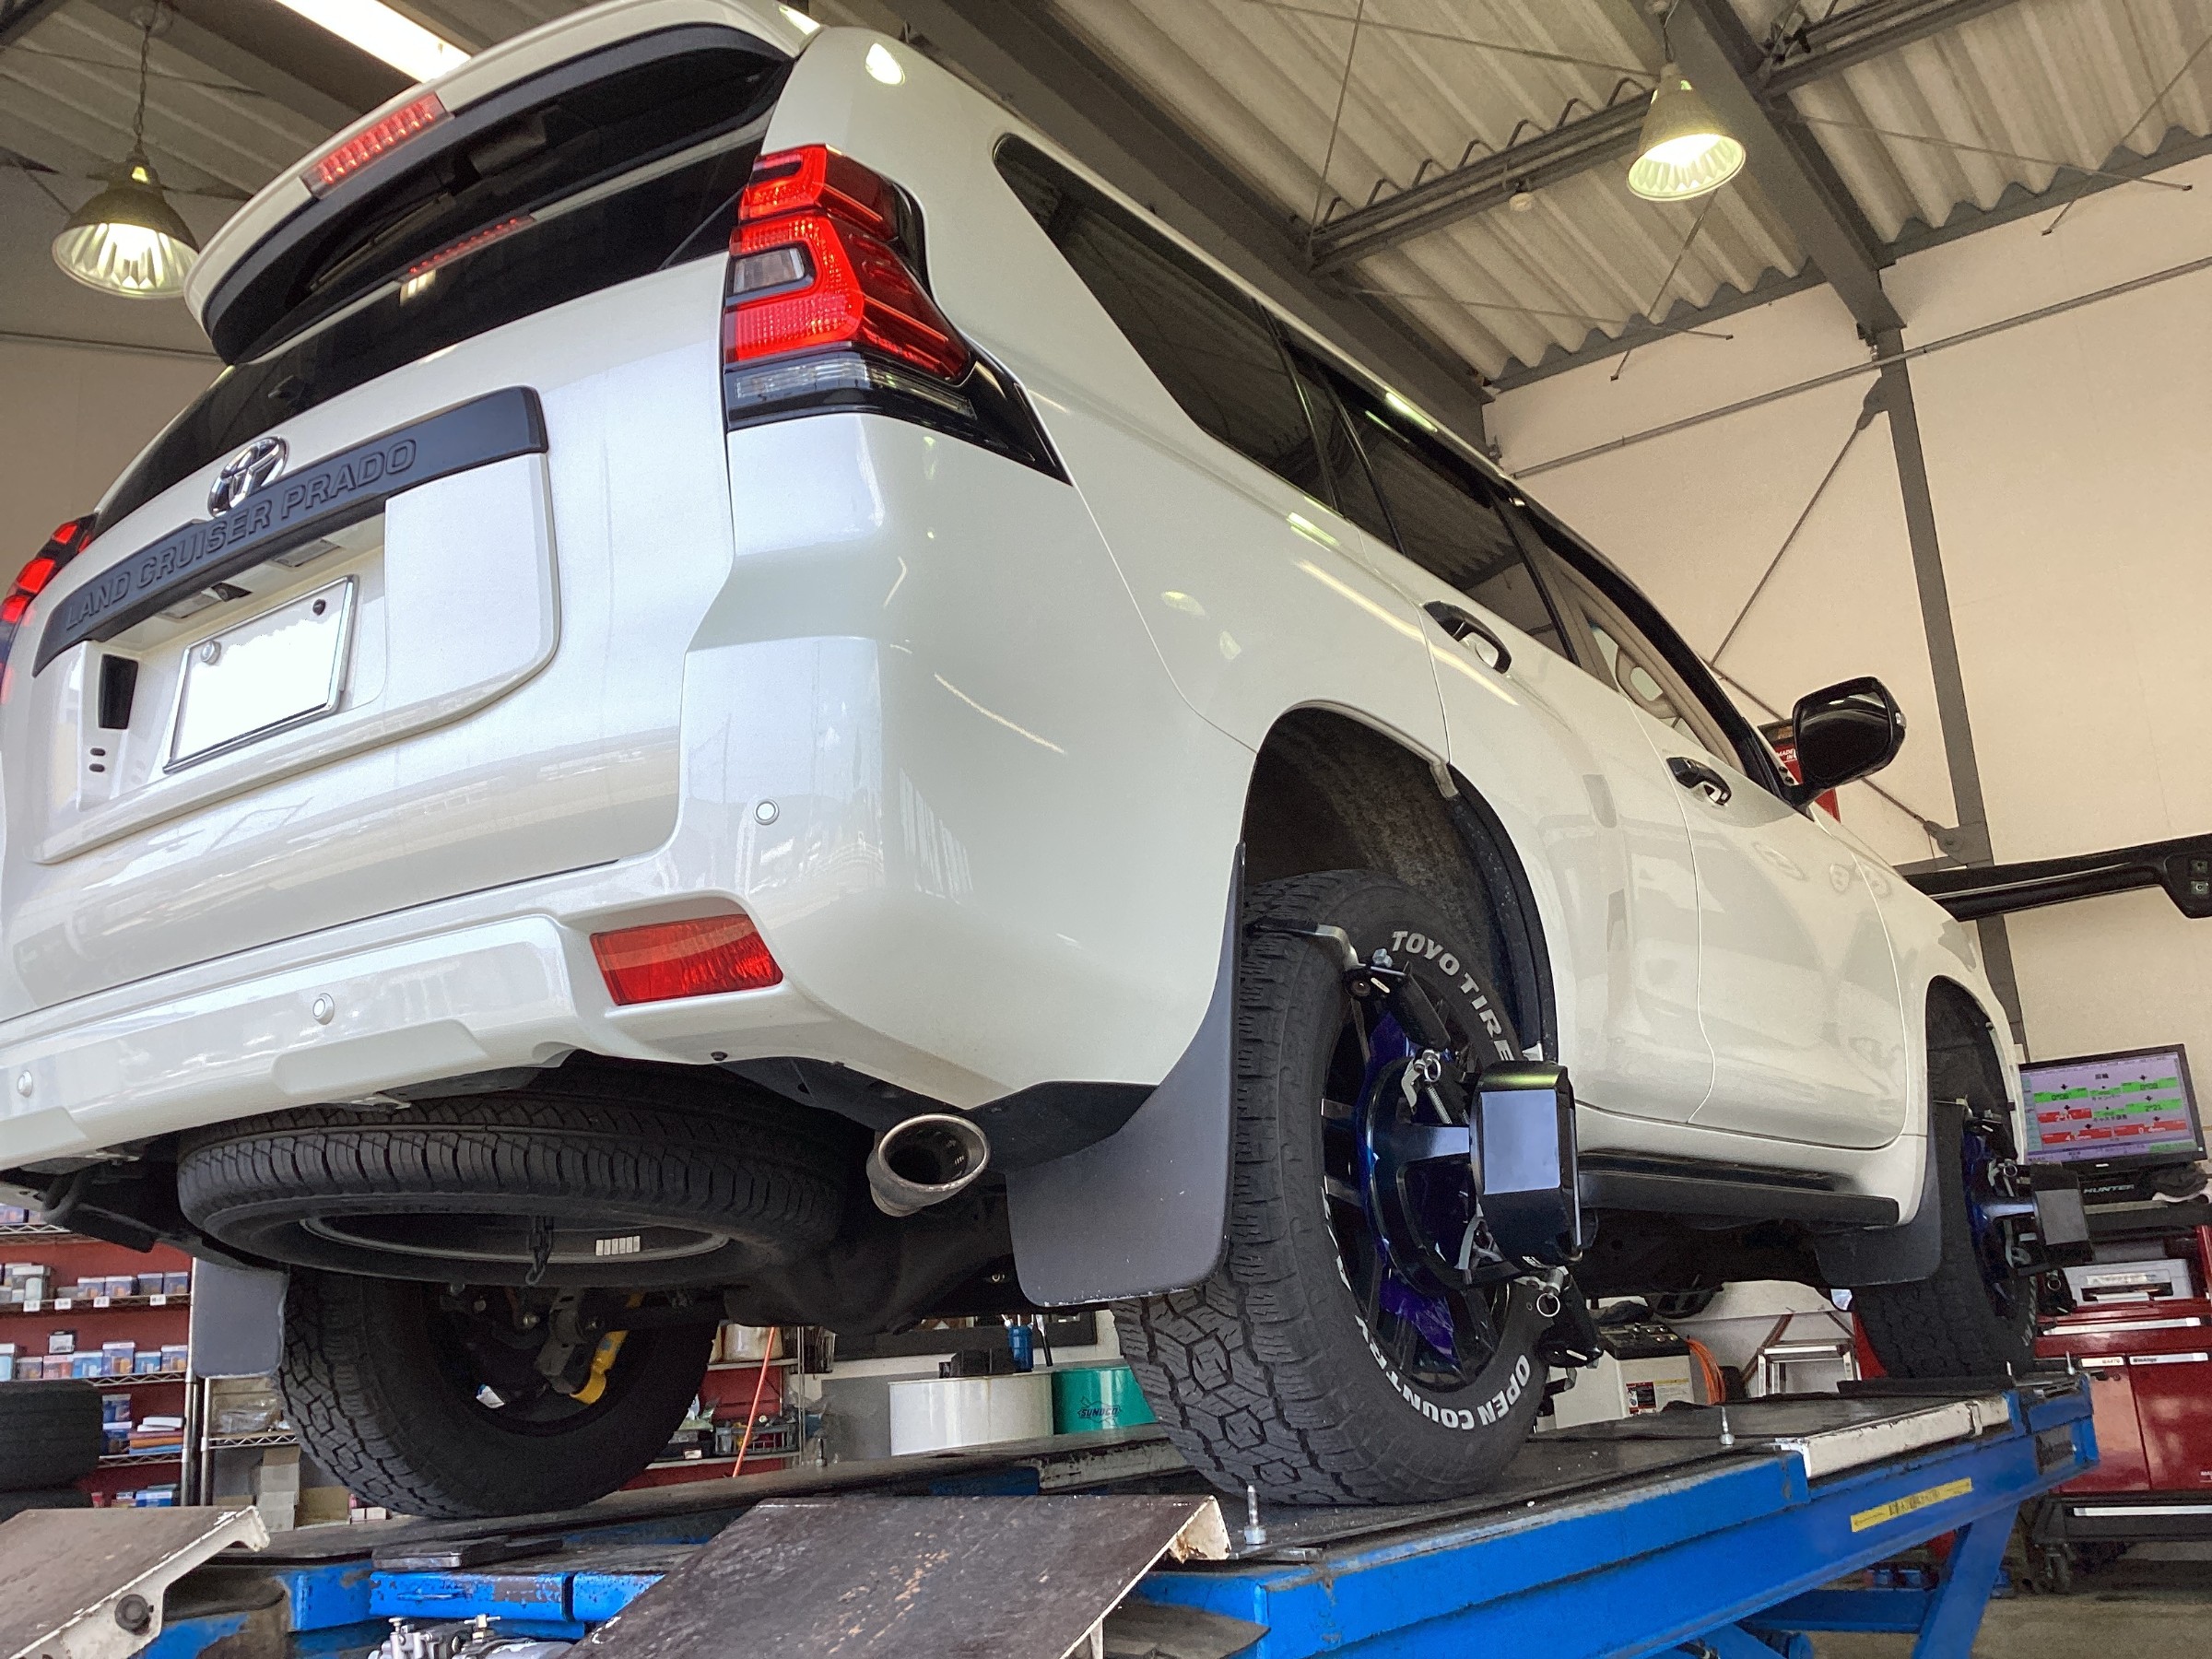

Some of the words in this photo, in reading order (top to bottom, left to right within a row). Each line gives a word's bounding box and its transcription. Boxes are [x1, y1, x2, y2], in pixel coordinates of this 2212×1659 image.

[65, 571, 131, 631] LAND
[136, 499, 273, 591] CRUISER
[280, 438, 417, 520] PRADO
[1391, 930, 1461, 977] TOYO
[2083, 1184, 2135, 1194] HUNTER
[1354, 1314, 1476, 1430] COUNTRY
[1477, 1354, 1531, 1427] OPEN
[1081, 1406, 1119, 1418] SUNOCO
